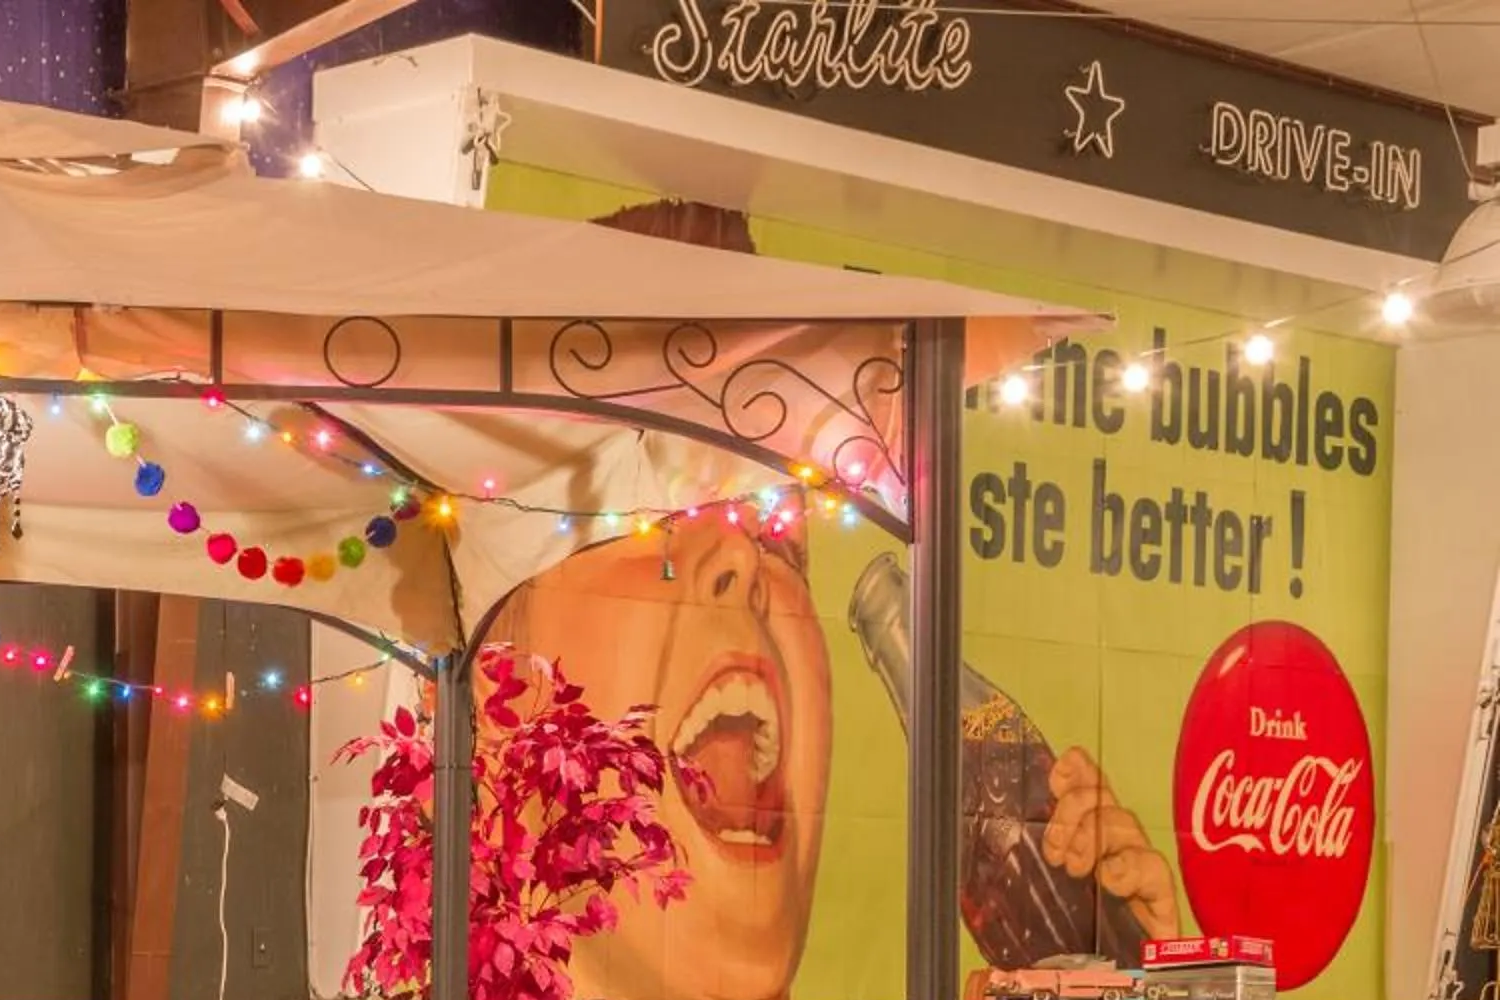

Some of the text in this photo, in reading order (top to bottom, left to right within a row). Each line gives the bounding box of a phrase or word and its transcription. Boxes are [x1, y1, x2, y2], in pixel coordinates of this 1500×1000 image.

[653, 0, 973, 88] Starlite
[1210, 101, 1422, 210] DRIVE-IN
[1150, 327, 1379, 477] bubbles
[968, 461, 1066, 568] ste
[1250, 706, 1308, 741] Drink
[1191, 748, 1363, 860] Coca-Cola
